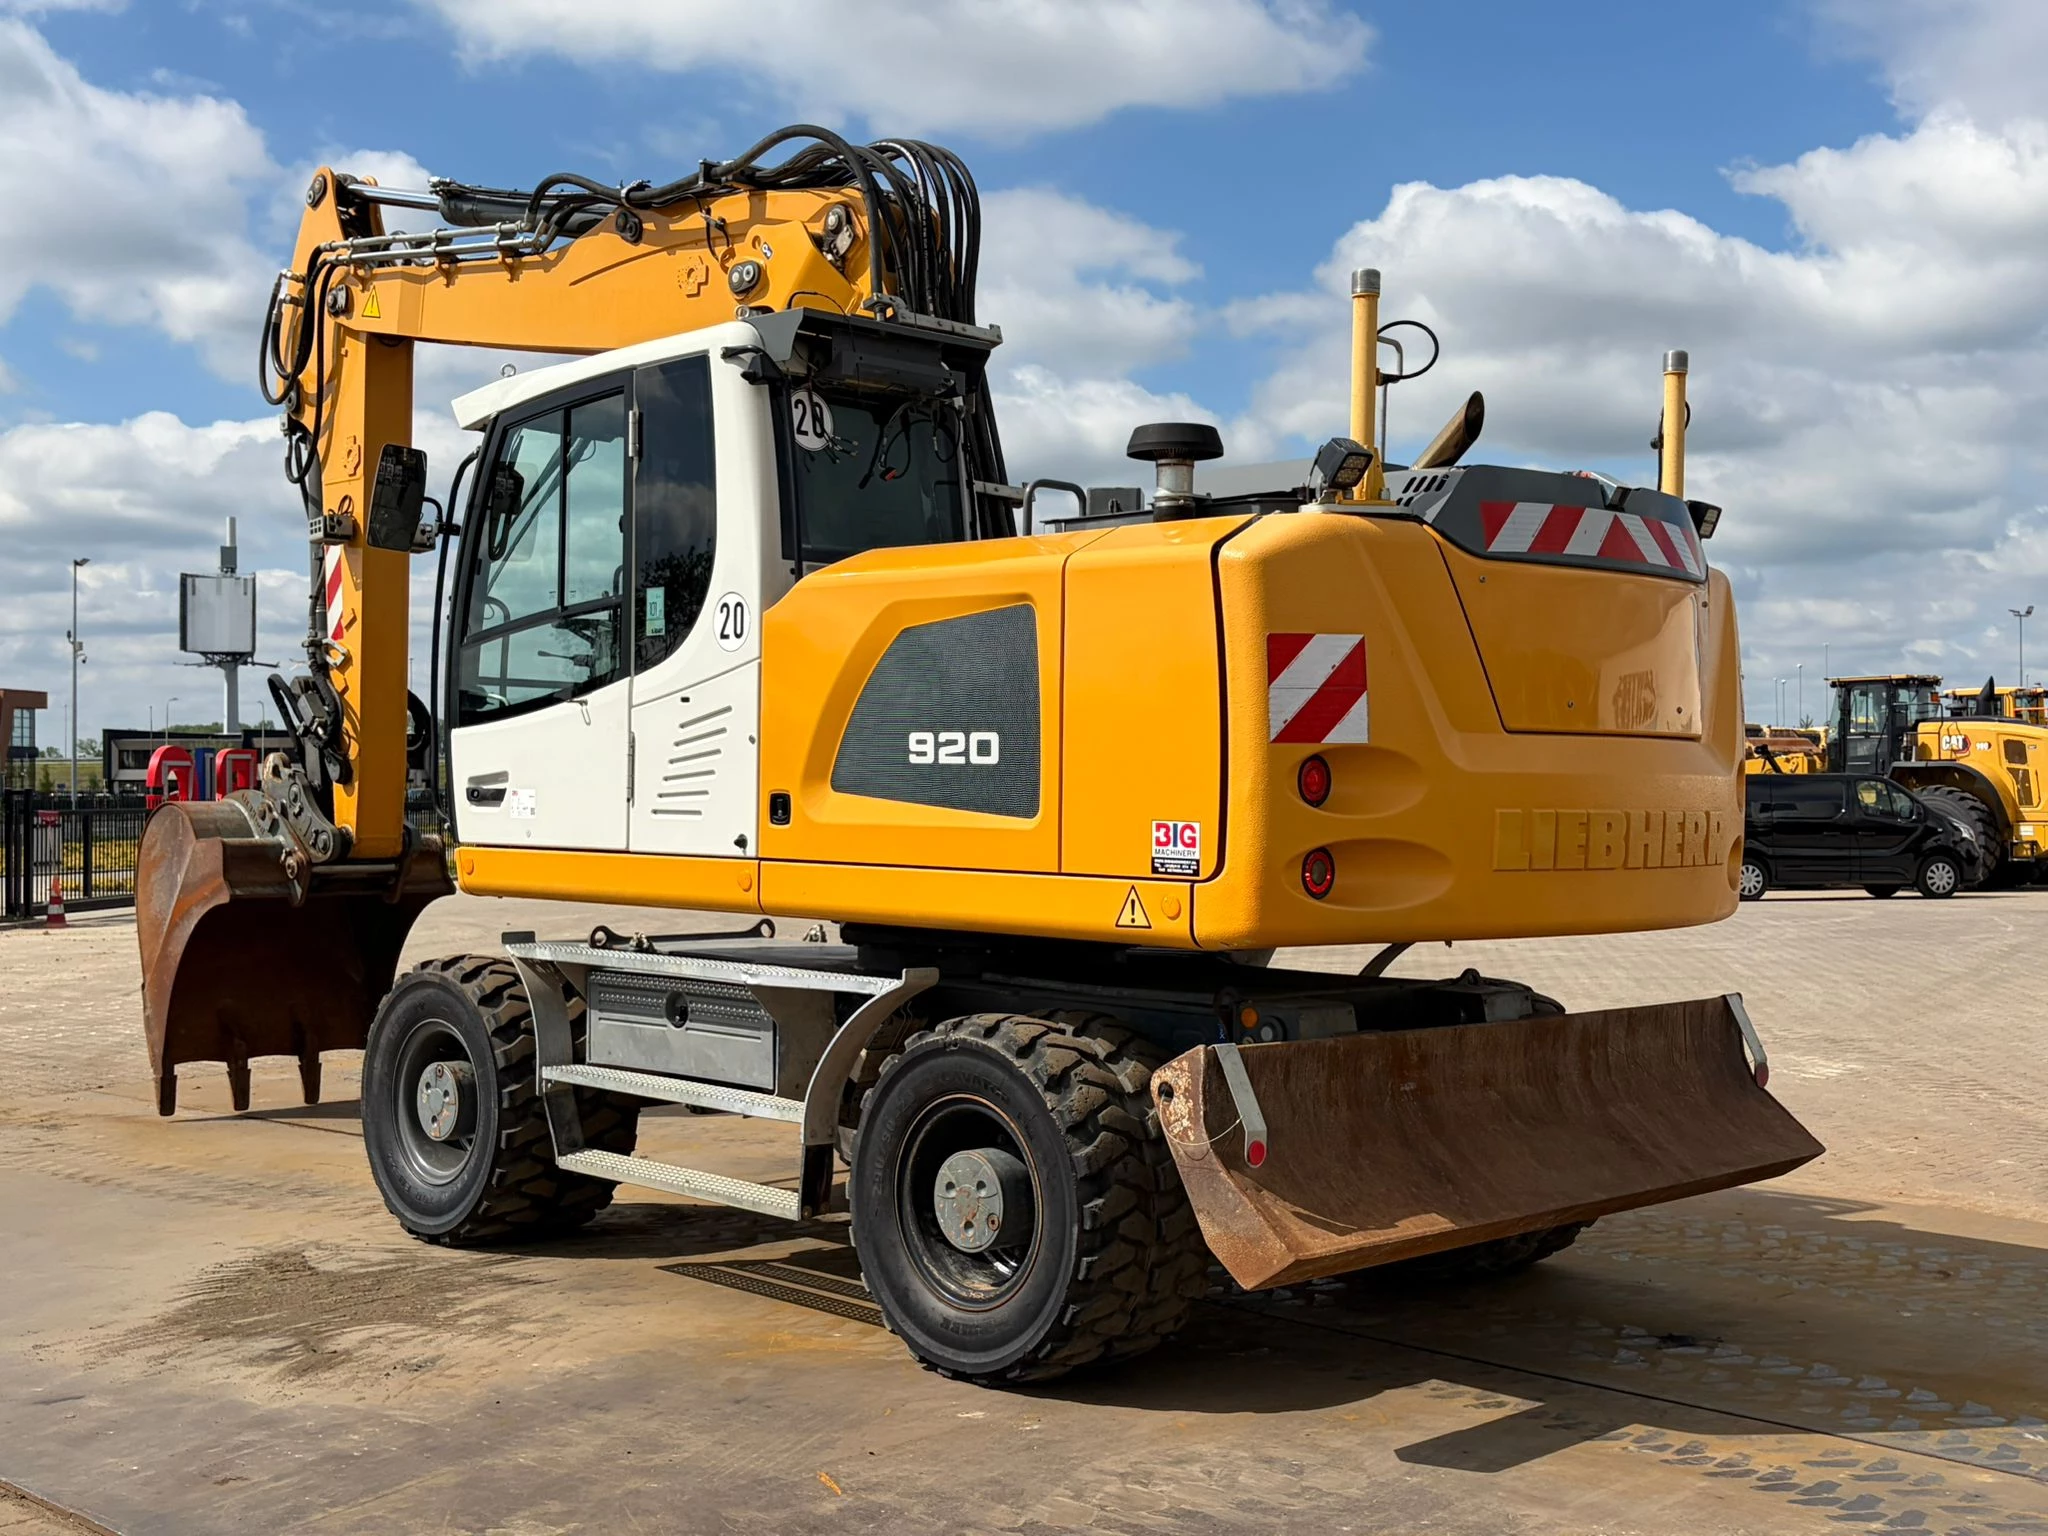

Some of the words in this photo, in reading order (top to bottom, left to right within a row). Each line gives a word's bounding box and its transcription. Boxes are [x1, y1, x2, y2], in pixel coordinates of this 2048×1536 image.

[794, 399, 824, 438] 20
[720, 601, 744, 640] 20
[908, 731, 1000, 765] 920
[1942, 735, 1964, 750] CAT
[1155, 822, 1197, 848] BIG
[1493, 808, 1723, 872] LIEBHERR
[1154, 848, 1197, 857] MACHINERY
